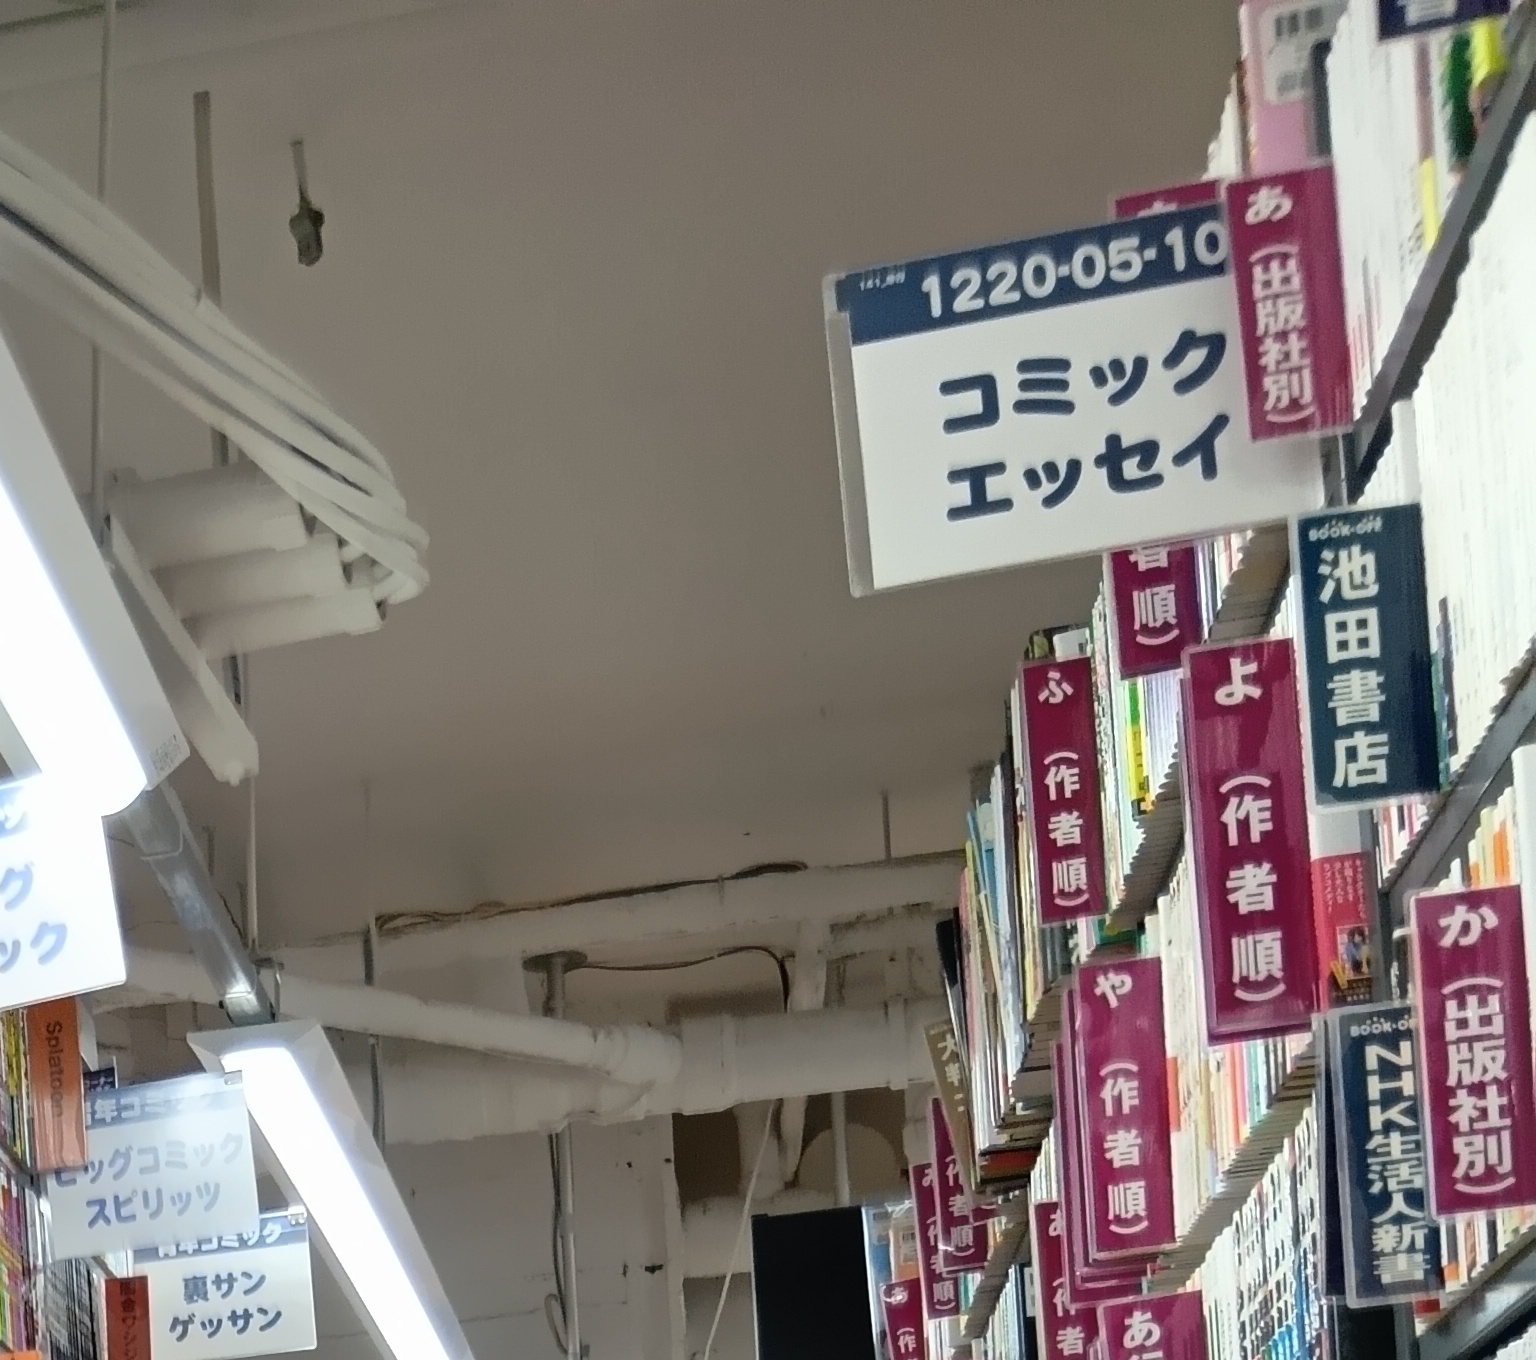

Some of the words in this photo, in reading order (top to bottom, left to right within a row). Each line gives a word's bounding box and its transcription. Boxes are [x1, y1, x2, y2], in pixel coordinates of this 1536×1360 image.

[921, 220, 1229, 317] 1220-05-10
[939, 329, 1227, 433] コミック
[1245, 186, 1316, 425] あ（出版社別）
[946, 414, 1230, 521] エッセイ
[1317, 543, 1390, 789] 池田書店
[1038, 671, 1088, 906] ふ（作者順）
[1214, 659, 1286, 1002] よ（作者順）
[45, 1021, 65, 1118] Splatoon
[1095, 971, 1149, 1234] や（作者順）
[1366, 1044, 1432, 1284] NHK生活人新書
[1439, 904, 1515, 1195] か（出版社別）
[86, 1181, 221, 1229] スピリッツ
[168, 1307, 283, 1342] ゲッサン
